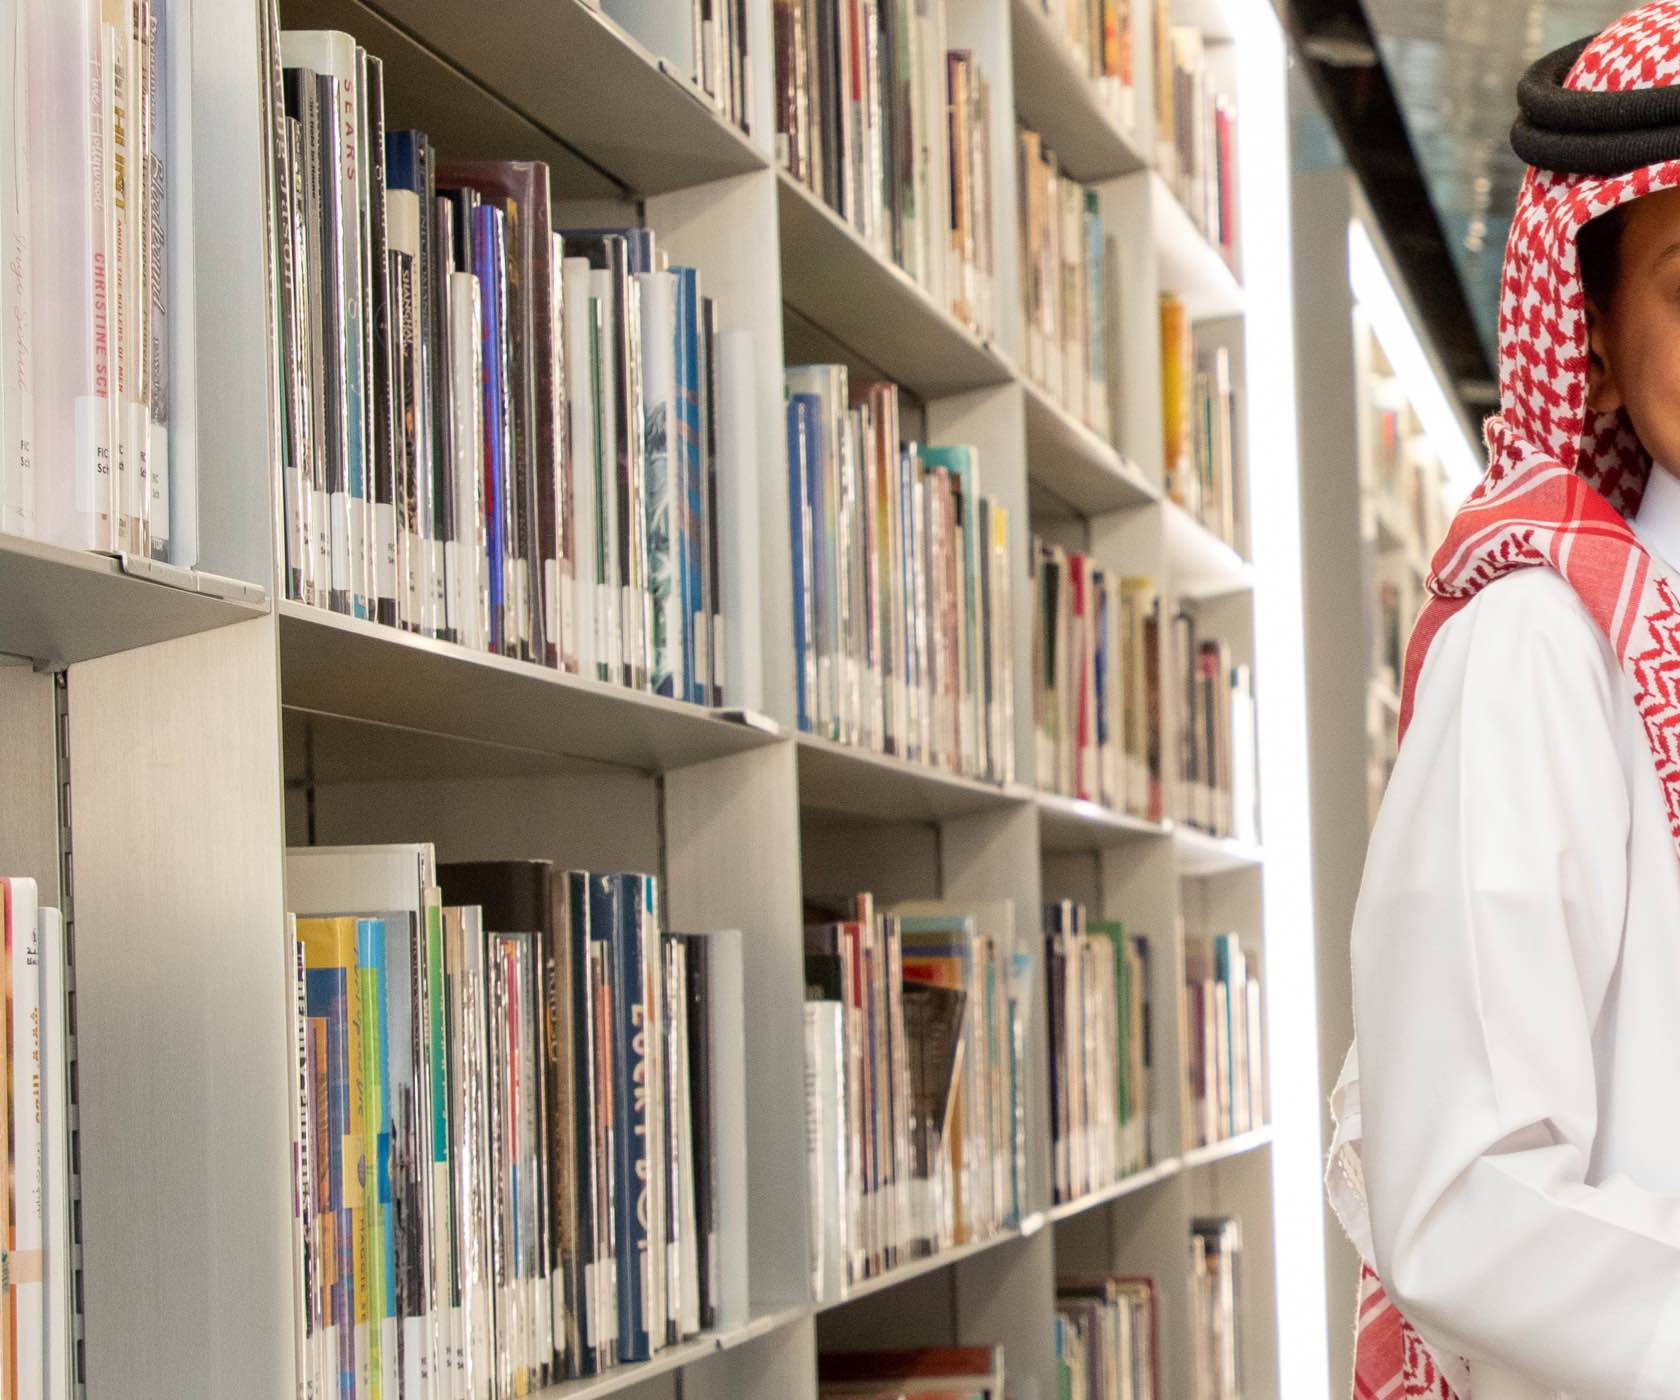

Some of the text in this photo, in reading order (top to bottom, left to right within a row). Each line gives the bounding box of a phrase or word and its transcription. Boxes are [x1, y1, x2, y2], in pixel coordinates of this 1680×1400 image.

[88, 111, 106, 210] Hollywood
[343, 78, 357, 181] SEARS
[280, 172, 293, 289] Jason
[95, 251, 108, 353] CHRISTINE
[97, 447, 109, 458] FIC
